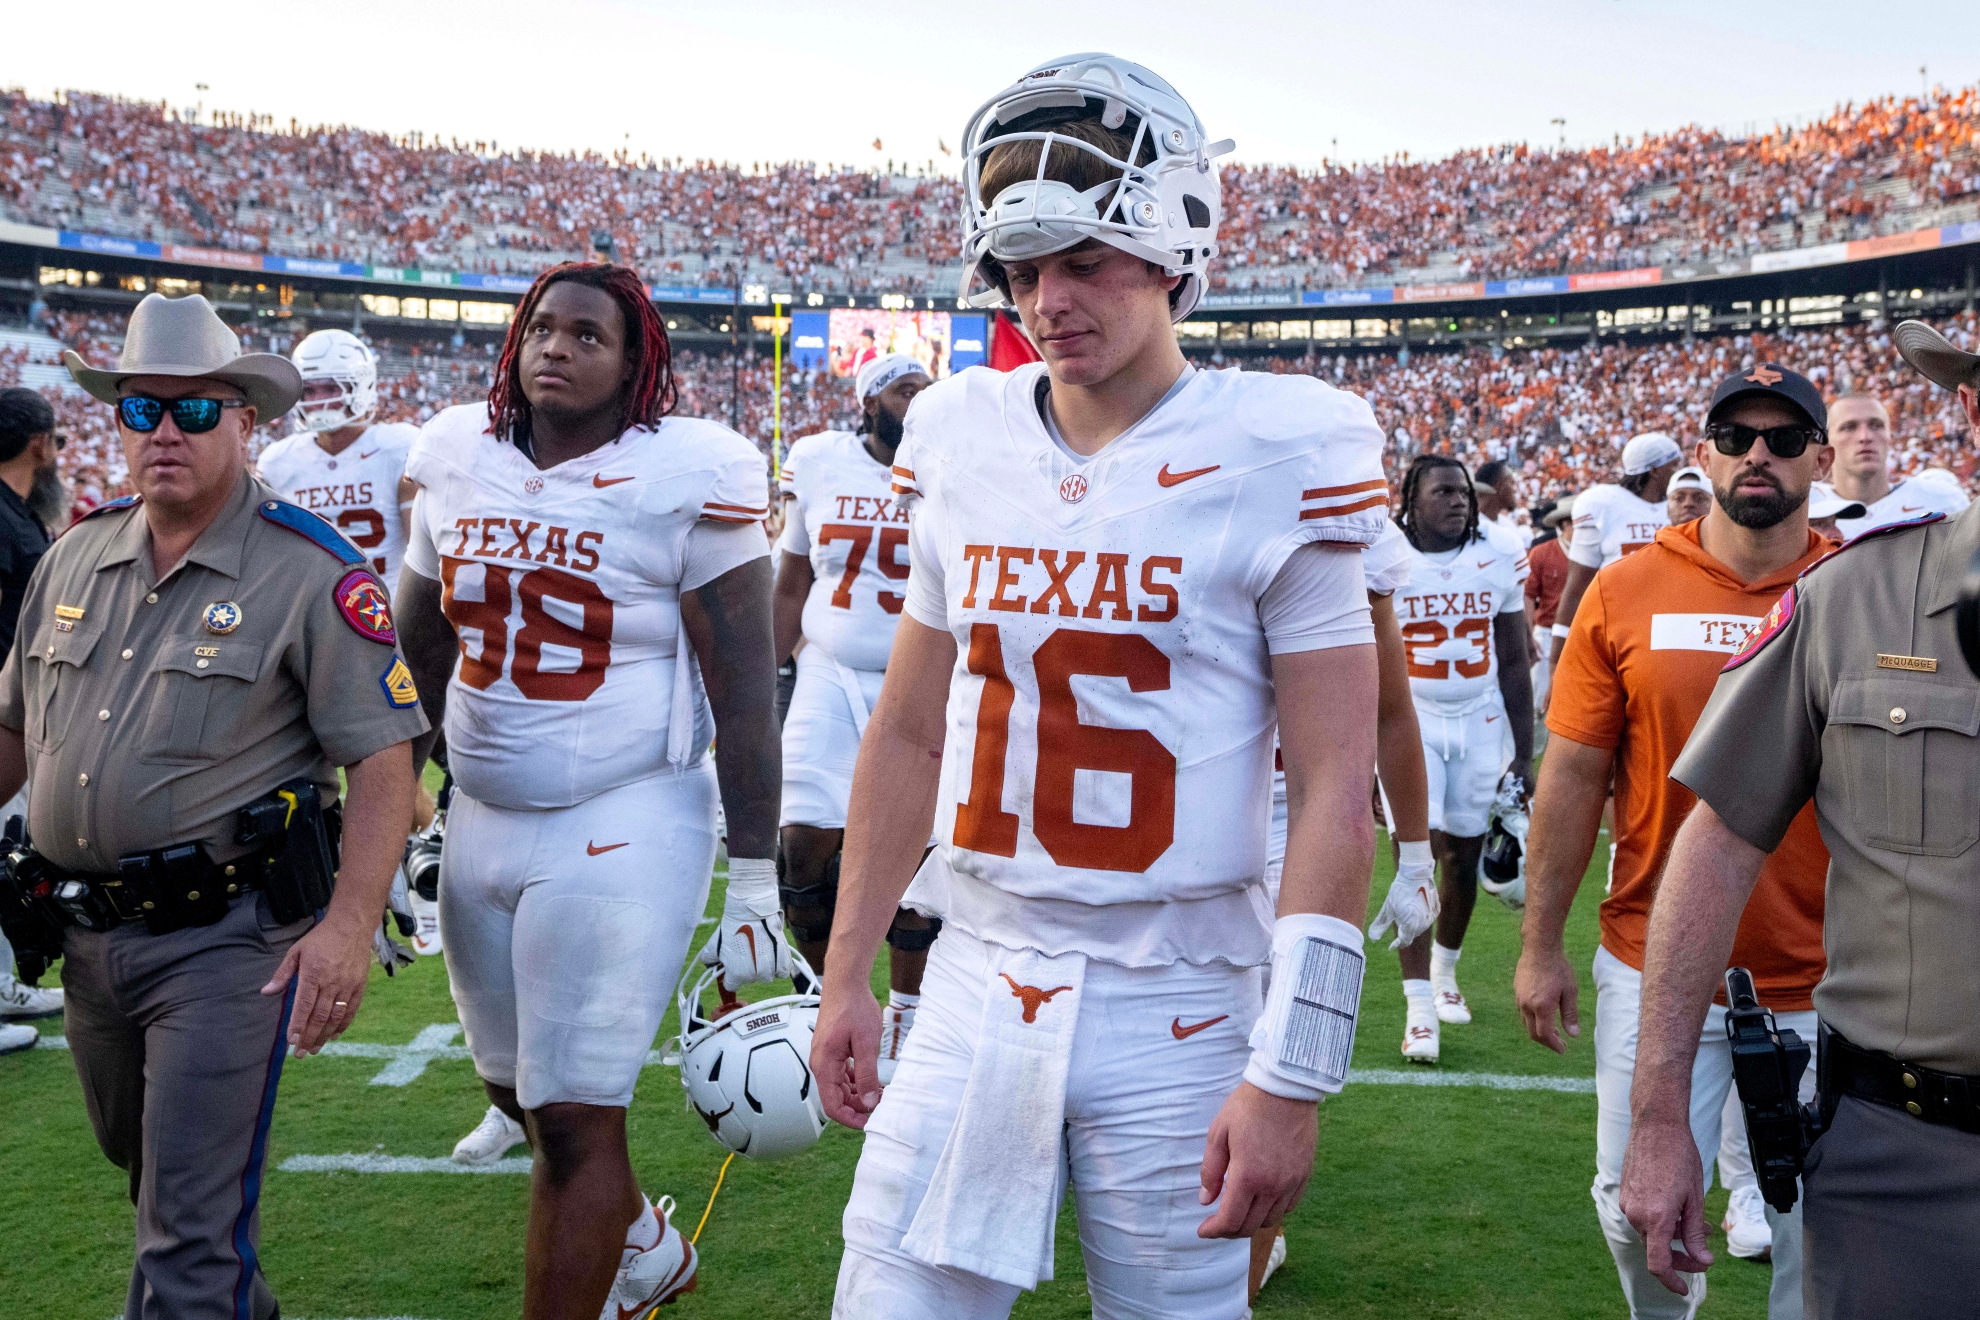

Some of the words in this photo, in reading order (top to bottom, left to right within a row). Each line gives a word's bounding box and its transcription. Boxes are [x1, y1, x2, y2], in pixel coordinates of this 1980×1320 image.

[876, 366, 898, 392] NIKE
[295, 482, 373, 509] TEXAS
[525, 476, 544, 494] SEC
[1060, 475, 1087, 501] SEC
[835, 495, 910, 523] TEXA
[453, 518, 604, 573] TEXAS
[962, 544, 1183, 623] TEXAS
[1403, 592, 1492, 618] TEXAS
[1700, 620, 1757, 647] TEX
[194, 646, 220, 657] CVE
[1402, 617, 1491, 680] 23
[953, 622, 1177, 874] 16
[746, 1012, 781, 1031] HORNS
